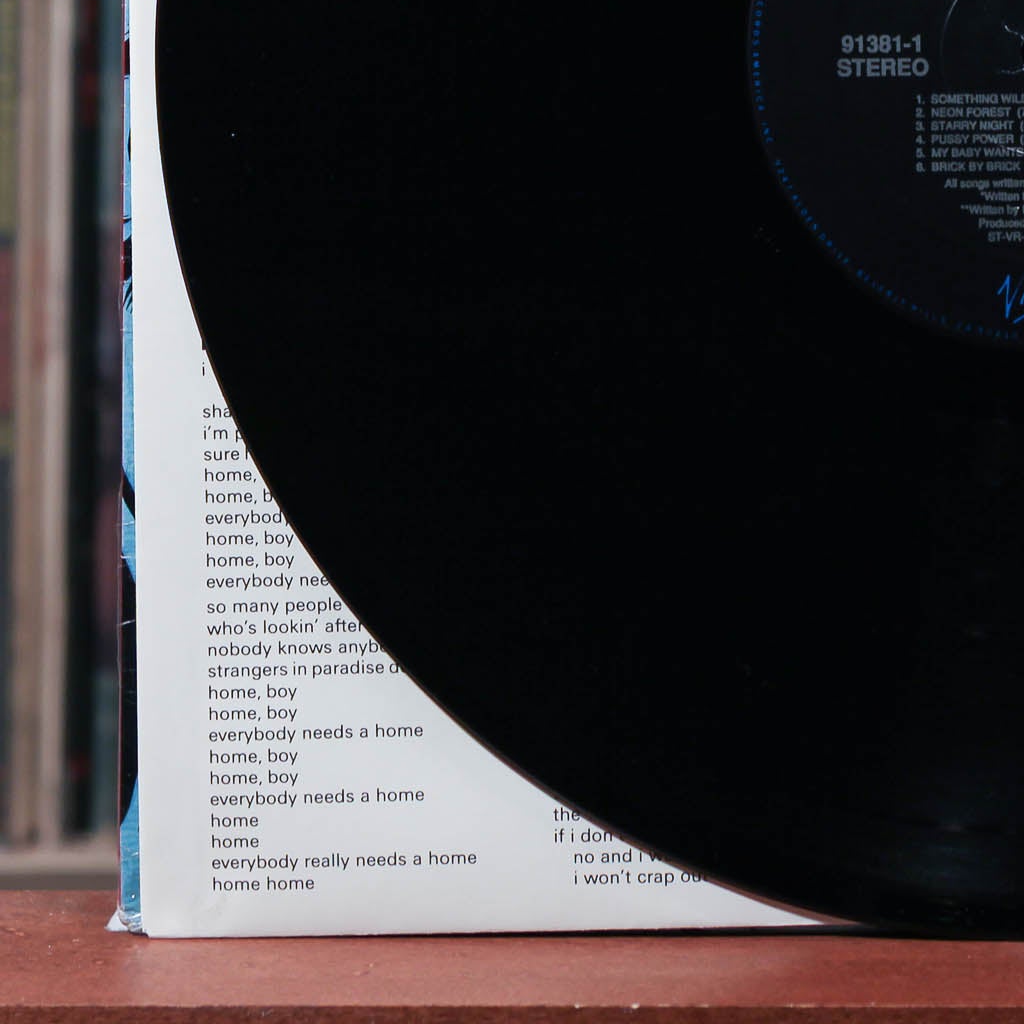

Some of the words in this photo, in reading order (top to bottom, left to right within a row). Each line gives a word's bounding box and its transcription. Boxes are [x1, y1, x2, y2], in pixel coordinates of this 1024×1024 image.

[841, 34, 921, 54] 91381-1
[837, 57, 929, 77] STEREO
[916, 94, 925, 104] 1.
[931, 93, 999, 104] SOMETHING
[916, 107, 925, 118] 2.
[931, 107, 963, 118] NEON
[966, 106, 1012, 118] FOREST
[915, 121, 925, 131] 3.
[931, 120, 977, 131] STARRY
[979, 120, 1014, 131] NIGHT
[916, 135, 925, 144] 4.
[931, 134, 970, 145] PUSSY
[972, 133, 1014, 146] POWER
[916, 148, 925, 158] 5.
[931, 147, 949, 158] MY
[951, 147, 982, 158] BABY
[983, 147, 1024, 158] WANTS
[931, 161, 966, 172] BRICK
[968, 161, 984, 172] BY
[986, 161, 1021, 171] BRICK
[208, 665, 288, 680] strangers
[293, 662, 307, 675] in
[312, 660, 384, 679] paradise
[209, 685, 261, 701] home,
[267, 684, 297, 701] boy
[212, 854, 298, 872] everybody
[305, 853, 350, 870] really
[356, 852, 406, 867] needs
[413, 855, 421, 865] a
[429, 851, 477, 865] home
[574, 871, 577, 885] i
[584, 869, 630, 884] won't
[638, 873, 674, 887] crap
